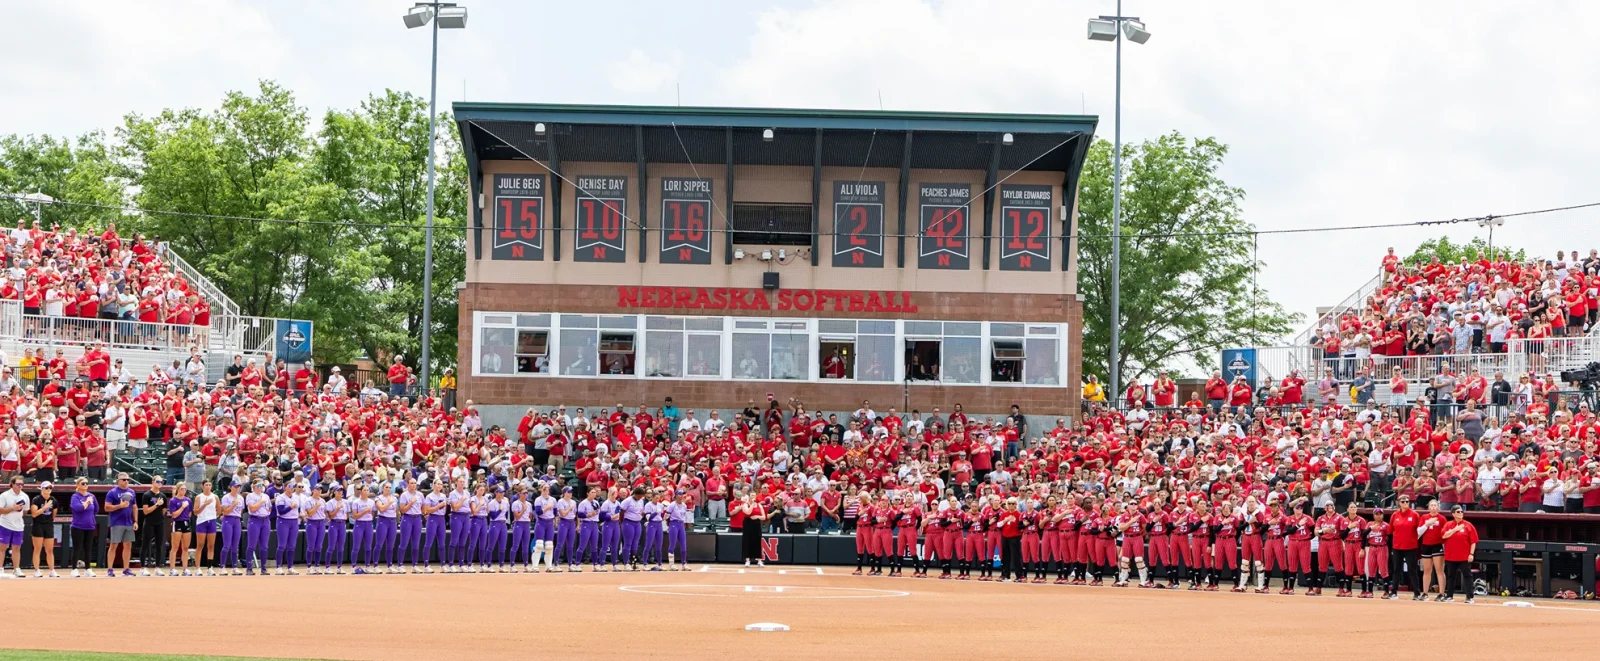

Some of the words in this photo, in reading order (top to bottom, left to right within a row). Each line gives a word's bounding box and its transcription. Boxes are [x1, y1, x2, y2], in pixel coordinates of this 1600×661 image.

[498, 177, 520, 189] JULIE
[522, 178, 541, 190] GEIS
[579, 178, 607, 190] DENISE
[608, 179, 624, 190] DAY
[664, 180, 682, 191] LORI
[683, 181, 711, 192] SIPPEL
[840, 184, 853, 195] ALI
[855, 184, 878, 196] VIOLA
[921, 187, 948, 197] PEACHES
[948, 188, 969, 198] JAMES
[1003, 190, 1023, 199] TAYLOR
[1023, 191, 1051, 200] EDWARDS
[499, 200, 537, 239] 15
[581, 201, 620, 240] 10
[668, 202, 704, 242] 16
[850, 206, 868, 246] 2
[925, 208, 964, 248] 42
[1008, 210, 1044, 249] 12
[511, 245, 524, 258] N
[593, 247, 606, 259] N
[679, 248, 692, 261] N
[852, 252, 865, 264] N
[938, 254, 950, 266] N
[1019, 256, 1032, 268] N
[617, 286, 770, 310] NEBRASKA
[777, 289, 918, 313] SOFTBALL
[761, 537, 779, 561] N
